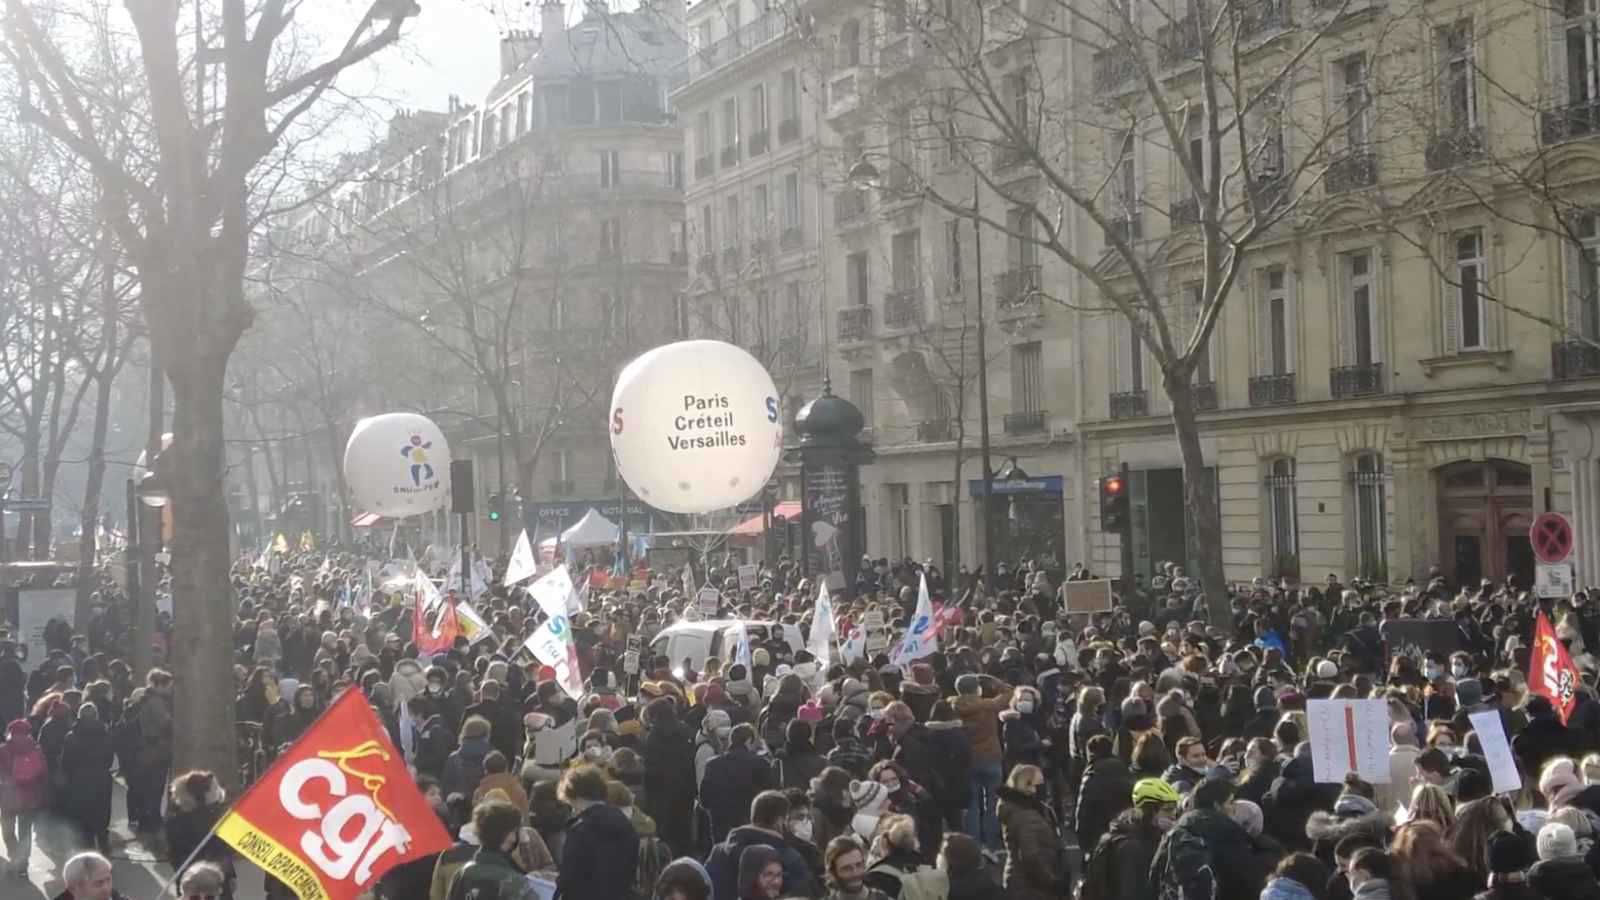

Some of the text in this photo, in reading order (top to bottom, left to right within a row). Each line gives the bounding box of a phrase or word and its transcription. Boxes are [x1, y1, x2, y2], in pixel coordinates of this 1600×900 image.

[684, 393, 729, 410] Paris
[675, 412, 733, 431] Créteil
[668, 432, 745, 450] Versailles
[279, 757, 412, 886] cgt
[238, 831, 273, 863] CONSEIL
